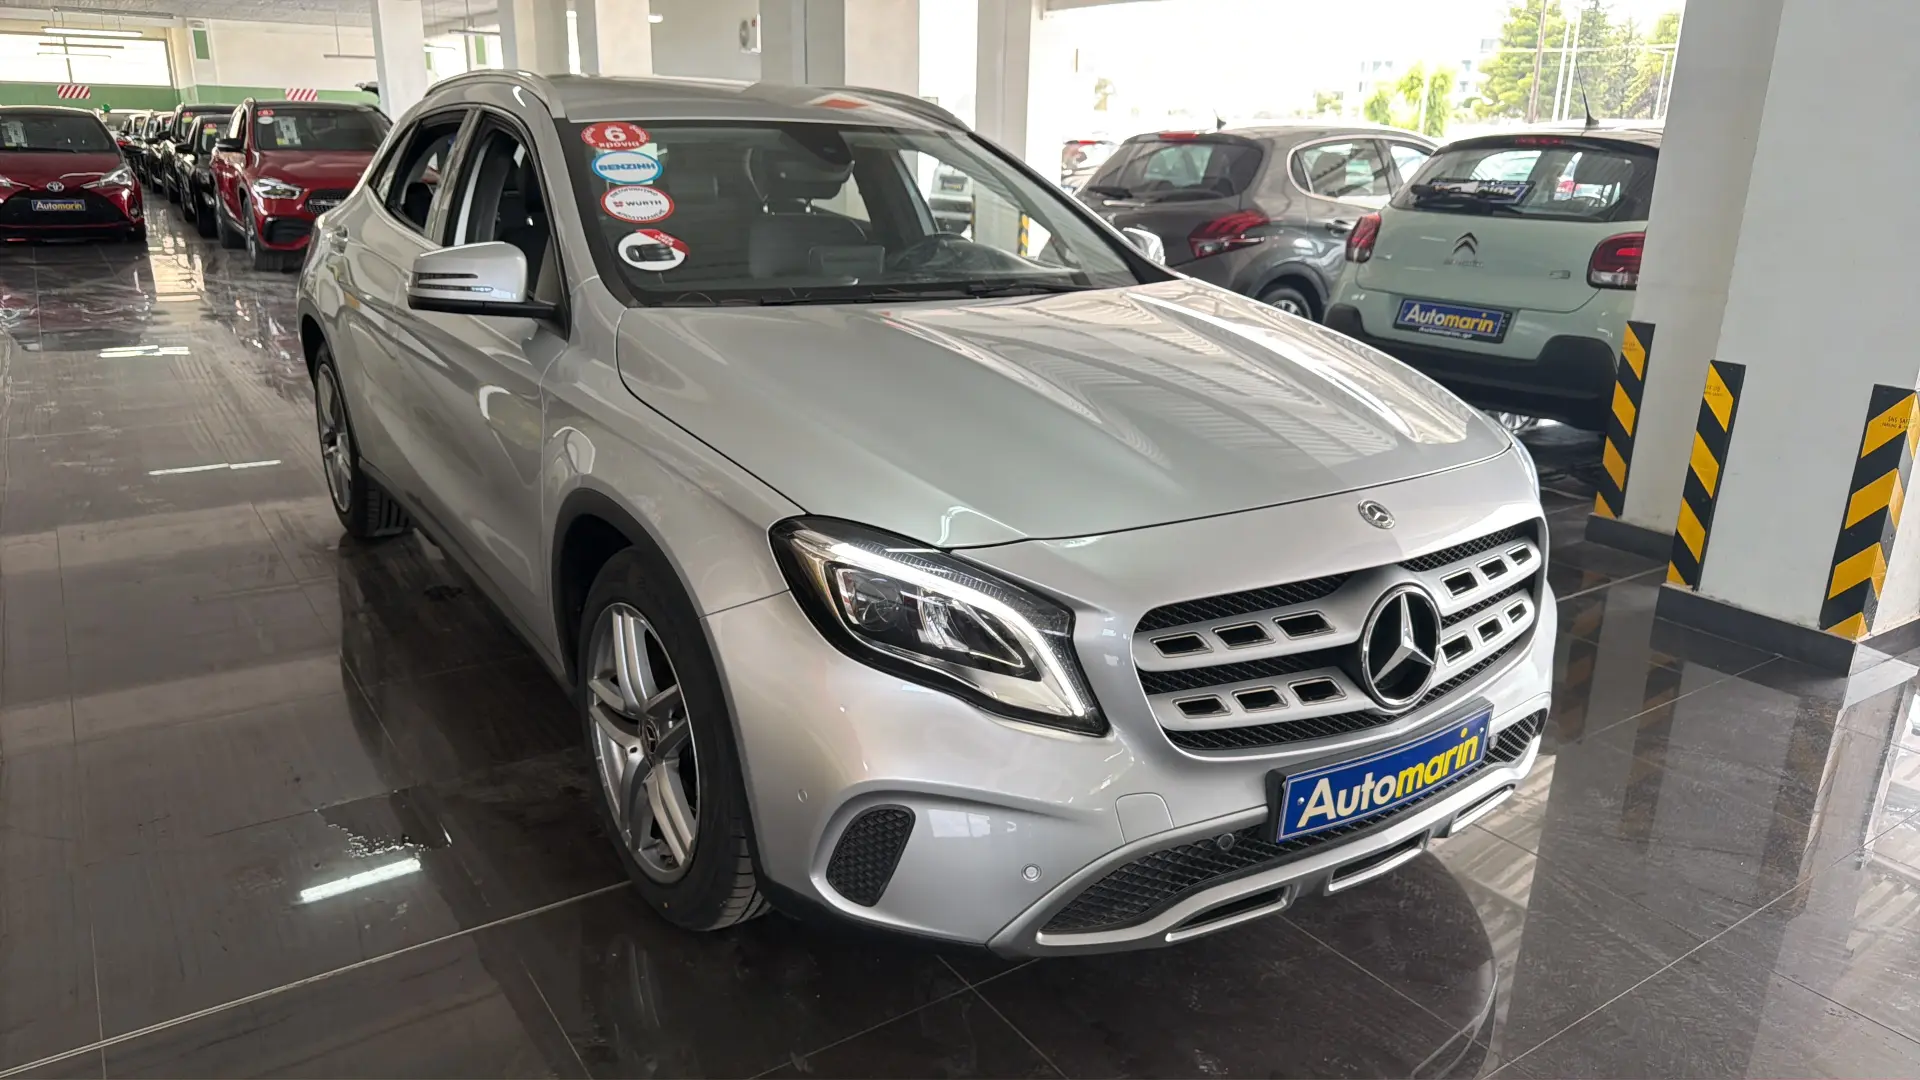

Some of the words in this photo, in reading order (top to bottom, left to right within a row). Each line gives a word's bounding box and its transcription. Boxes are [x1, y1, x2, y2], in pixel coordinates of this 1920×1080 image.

[604, 125, 627, 142] 6
[36, 201, 83, 210] Automarin
[1404, 303, 1495, 333] Automarin
[1296, 727, 1479, 829] Automarin
